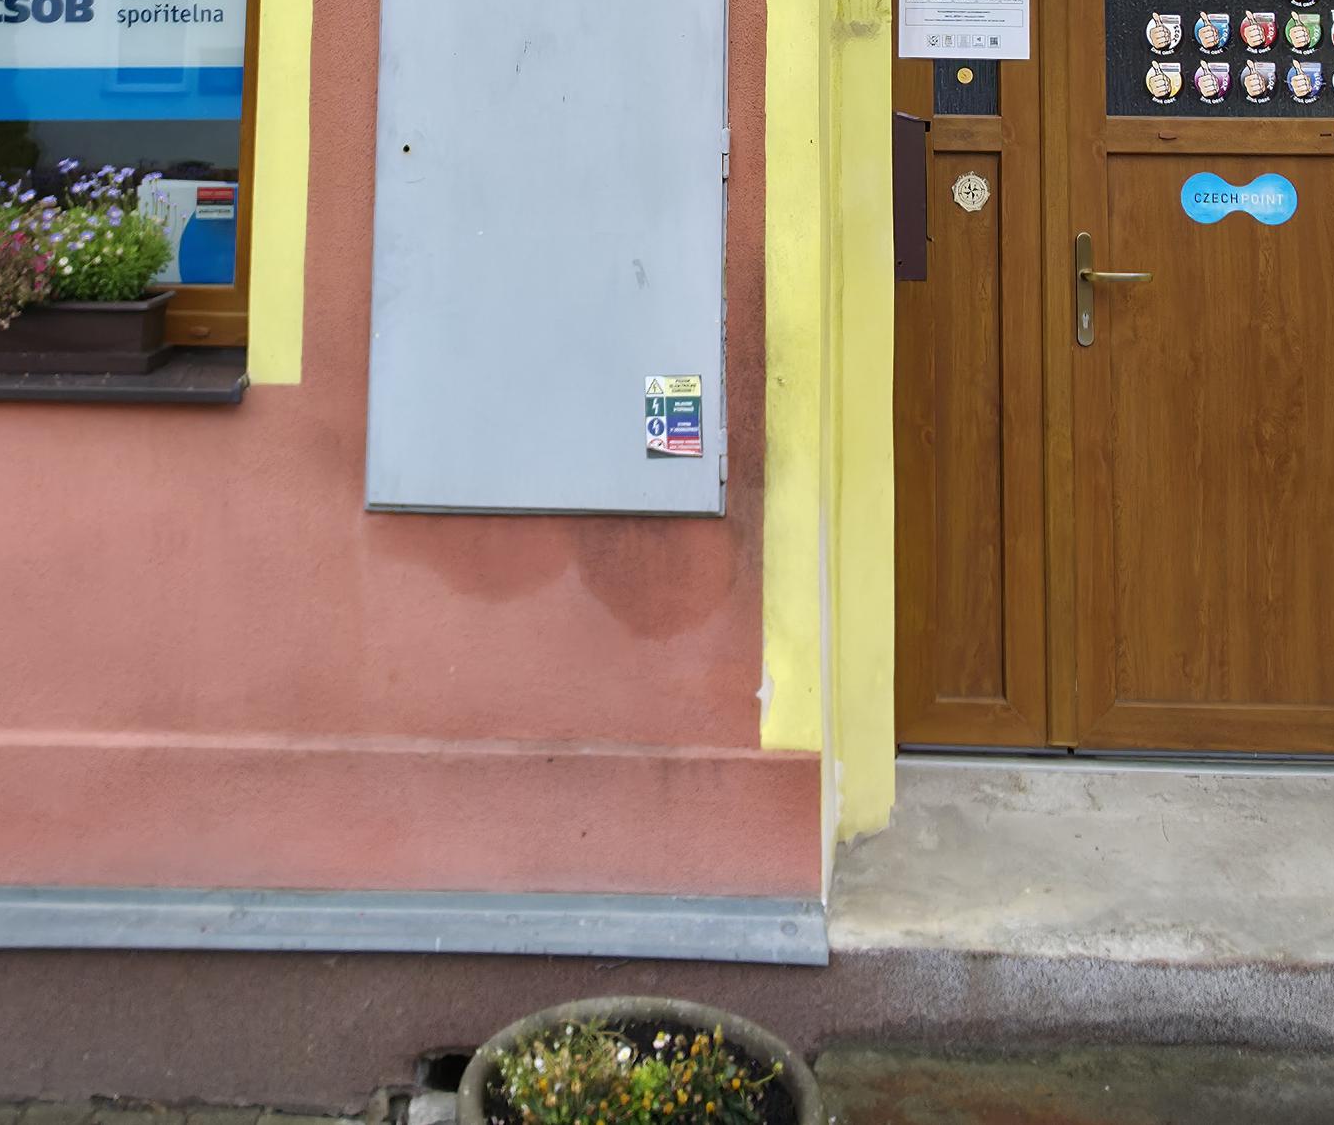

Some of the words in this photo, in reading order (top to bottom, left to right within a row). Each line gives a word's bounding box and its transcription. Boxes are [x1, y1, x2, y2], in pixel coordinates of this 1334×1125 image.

[117, 4, 224, 28] spořitelna
[1194, 193, 1239, 204] CZECH
[1241, 193, 1284, 205] POINT
